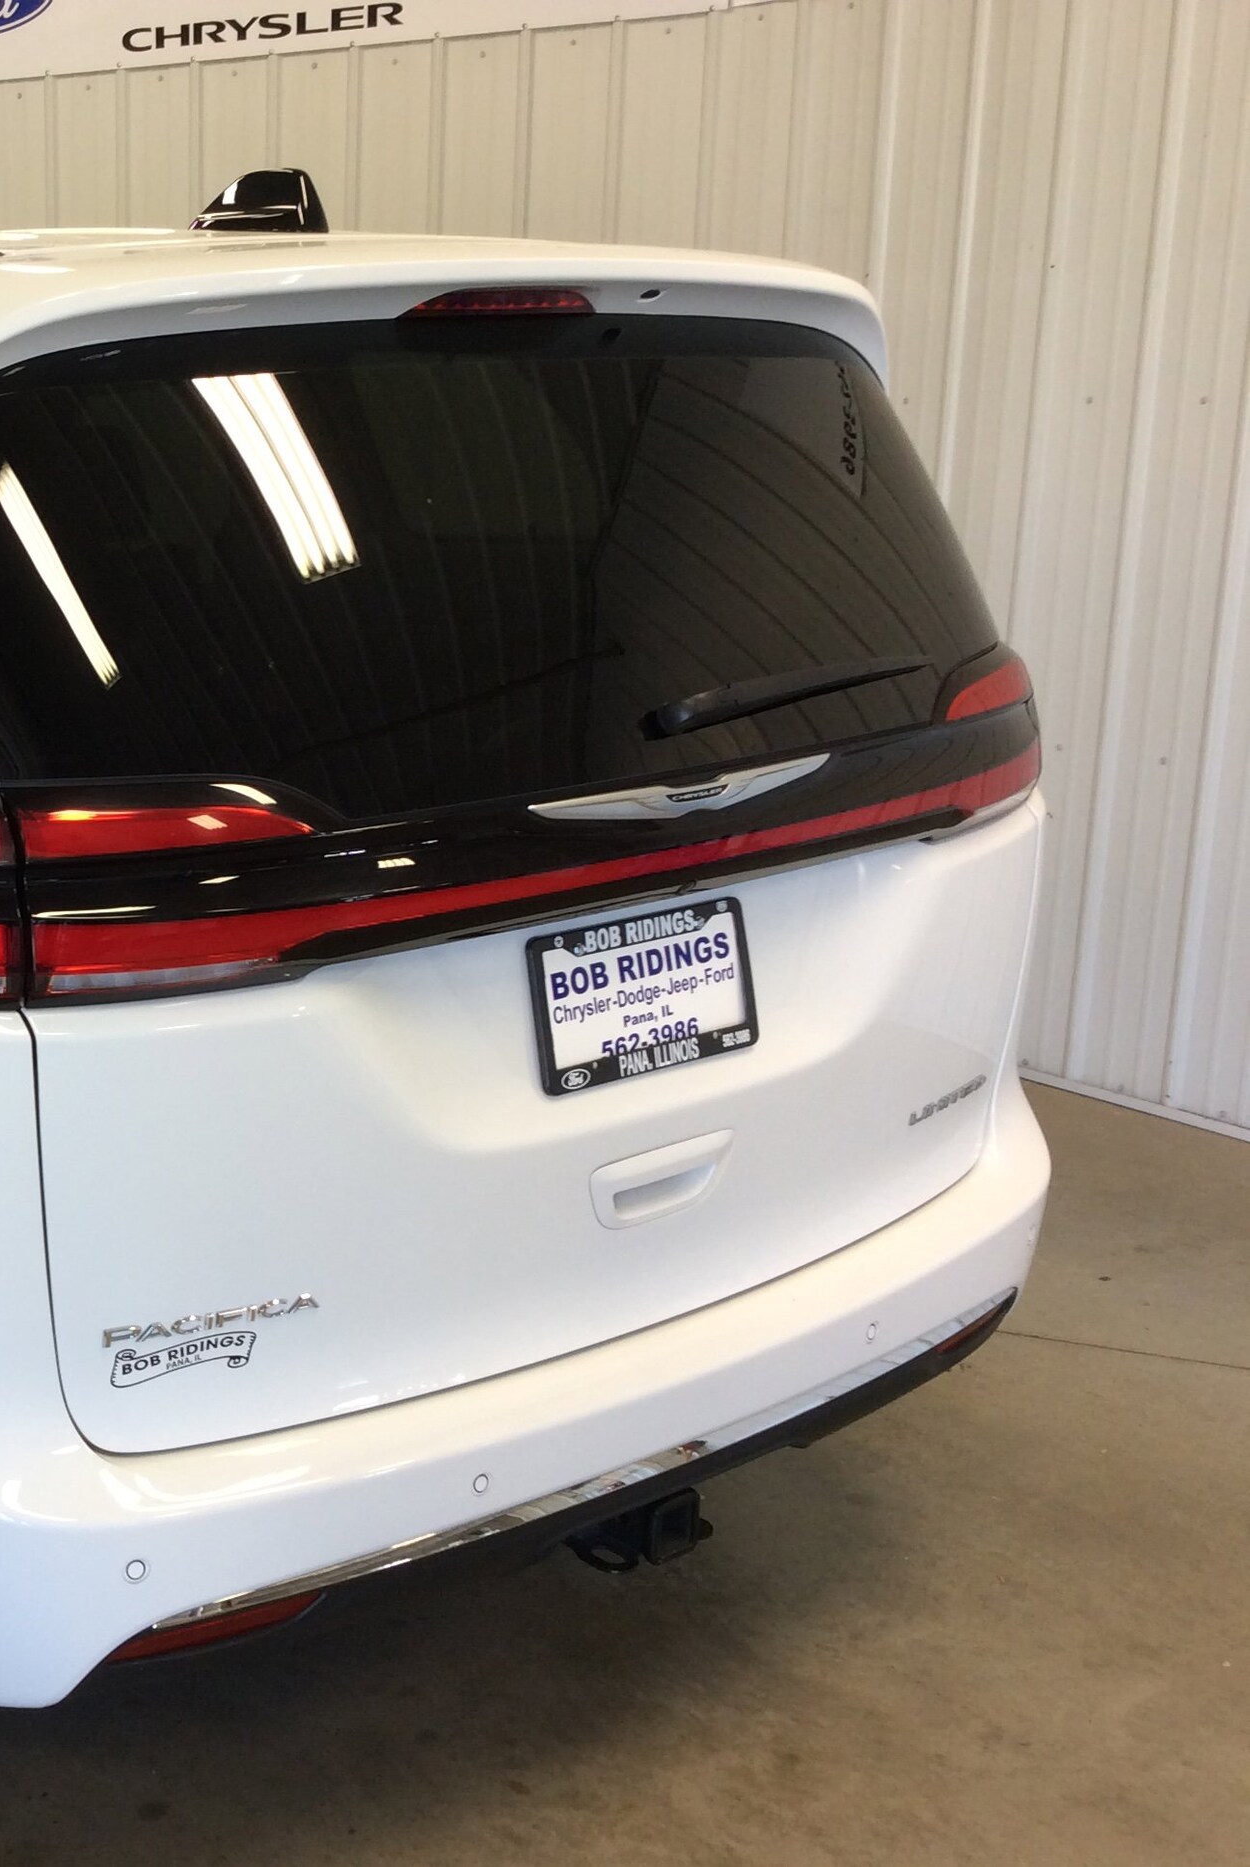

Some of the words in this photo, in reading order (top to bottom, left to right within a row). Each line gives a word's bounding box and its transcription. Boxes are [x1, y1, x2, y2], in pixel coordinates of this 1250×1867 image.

[122, 2, 404, 52] CHRYSLER
[584, 925, 621, 953] BOB
[625, 909, 695, 944] RIDINGS
[550, 961, 609, 1000] BOB
[617, 932, 730, 983] RIDINGS
[553, 963, 735, 1024] Chrysler-Dodge-Jeep-Ford
[601, 1017, 699, 1057] 562-3986
[622, 1010, 659, 1028] Pana,
[661, 1005, 674, 1018] IL
[654, 1037, 700, 1069] ILLINOIS
[102, 1292, 320, 1348] PACIFICA
[122, 1355, 161, 1375] BOB
[167, 1335, 246, 1361] RIDINGS
